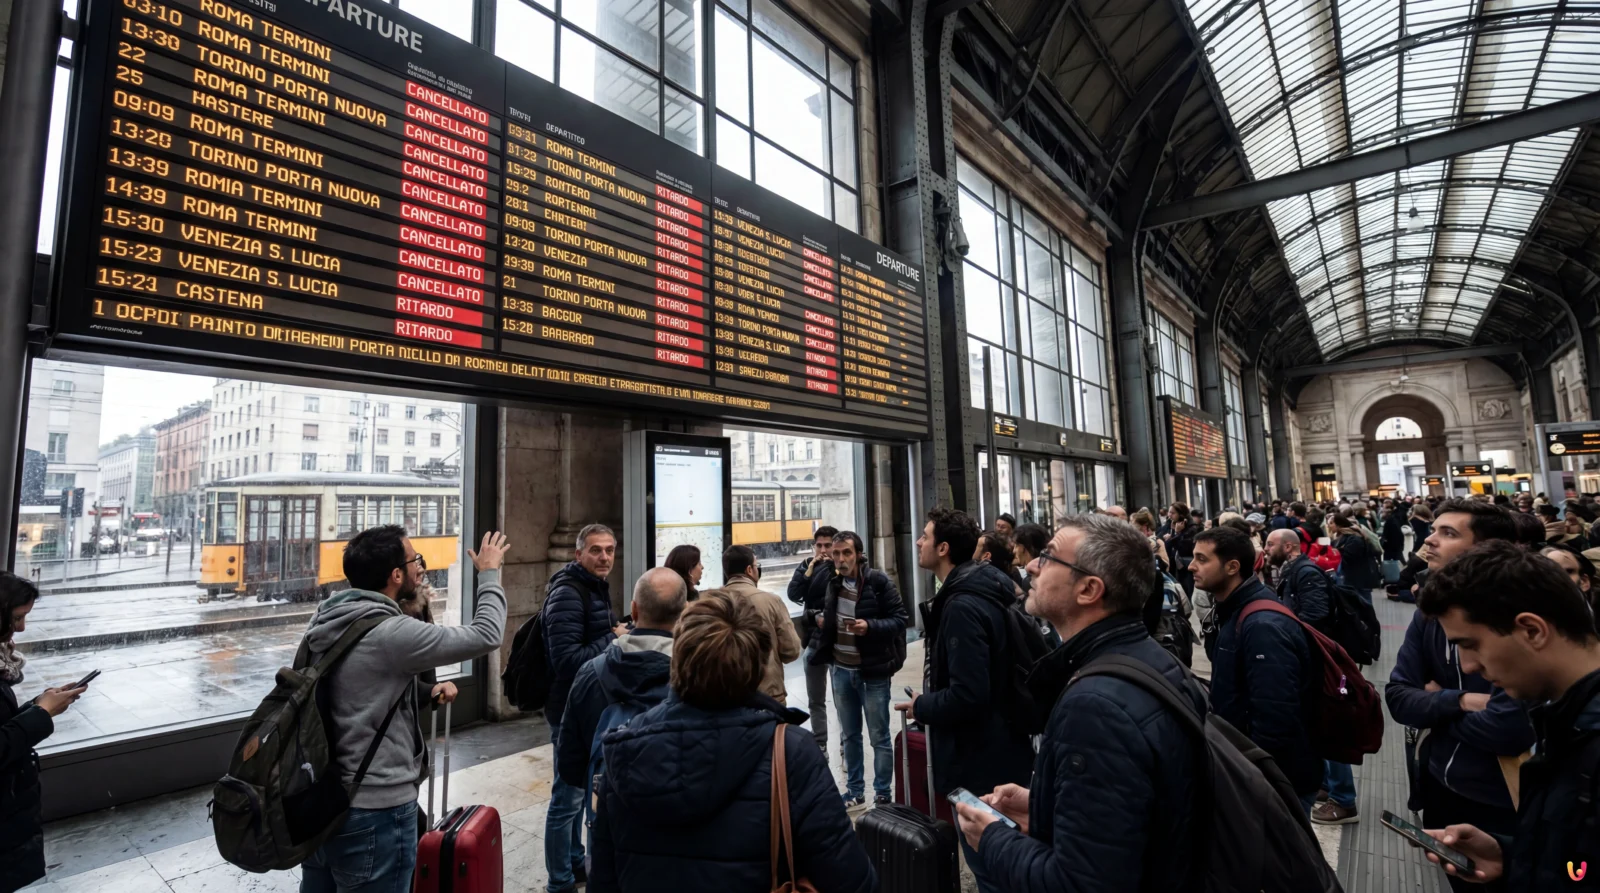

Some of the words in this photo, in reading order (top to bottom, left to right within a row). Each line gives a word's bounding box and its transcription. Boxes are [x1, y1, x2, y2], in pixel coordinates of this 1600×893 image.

[198, 21, 251, 54] ROMA
[259, 44, 330, 84] TERMINI
[407, 104, 486, 142] CANCELLATO
[200, 0, 253, 31] ROMA
[261, 20, 331, 62] TERMINI
[408, 83, 487, 123] CANCELLATO
[116, 65, 144, 86] 25
[192, 90, 274, 129] HASTERE
[403, 162, 484, 197] CANCELLATO
[118, 41, 147, 64] 22
[194, 68, 248, 100] ROMA
[255, 89, 326, 126] TERMINI
[404, 144, 484, 180] CANCELLATO
[197, 45, 266, 83] TORINO
[273, 73, 328, 107] PORTA
[335, 96, 387, 127] NUOVA
[406, 124, 485, 162] CANCELLATO
[113, 90, 175, 122] 09:09
[190, 113, 244, 144] ROMA
[251, 132, 324, 168] TERMINI
[402, 182, 483, 216] CANCELLATO
[546, 139, 574, 160] ROMA
[577, 151, 616, 177] TERMINI
[657, 185, 689, 206] RITARDO
[109, 147, 169, 177] 13:39
[251, 185, 323, 218] TERMINI
[400, 227, 482, 259] CANCELLATO
[188, 140, 258, 174] TORINO
[265, 163, 322, 192] PORTA
[328, 181, 381, 209] NUOVA
[401, 204, 482, 237] CANCELLATO
[546, 156, 582, 180] TORINO
[584, 173, 615, 194] PORTA
[617, 186, 647, 206] NUOVA
[657, 202, 689, 221] RITARDO
[103, 207, 164, 234] 15:30
[180, 223, 262, 256] VENEZIA
[269, 243, 284, 261] S.
[291, 248, 341, 273] LUCIA
[398, 273, 481, 302] CANCELLATO
[106, 177, 167, 205] 14:39
[183, 195, 238, 222] ROMA
[244, 210, 317, 242] TERMINI
[399, 250, 481, 281] CANCELLATO
[544, 225, 581, 247] TORINO
[584, 238, 614, 258] PORTA
[617, 250, 647, 267] NUOVA
[657, 262, 689, 280] RITARDO
[657, 217, 689, 236] RITARDO
[657, 232, 689, 251] RITARDO
[657, 248, 689, 265] RITARDO
[101, 237, 162, 263] 15:23
[178, 251, 260, 282] VENEZIA
[267, 270, 283, 286] S.
[288, 274, 338, 298] LUCIA
[397, 297, 454, 319] RITARDO
[543, 245, 588, 267] VENEZIA
[657, 279, 689, 296] RITARDO
[543, 265, 572, 283] ROMA
[576, 273, 616, 294] TERMINI
[657, 296, 689, 313] RITARDO
[876, 251, 920, 282] DEPARTURE
[176, 281, 263, 310] CASTENA
[396, 321, 453, 342] RITARDO
[503, 275, 517, 289] 21
[543, 285, 580, 304] TORINO
[583, 295, 614, 313] PORTA
[617, 304, 647, 320] NUOVA
[657, 314, 689, 330] RITARDO
[189, 314, 257, 337] PAINTO
[350, 339, 395, 357] PORTA
[657, 331, 689, 347] RITARDO
[657, 349, 689, 364] RITARDO
